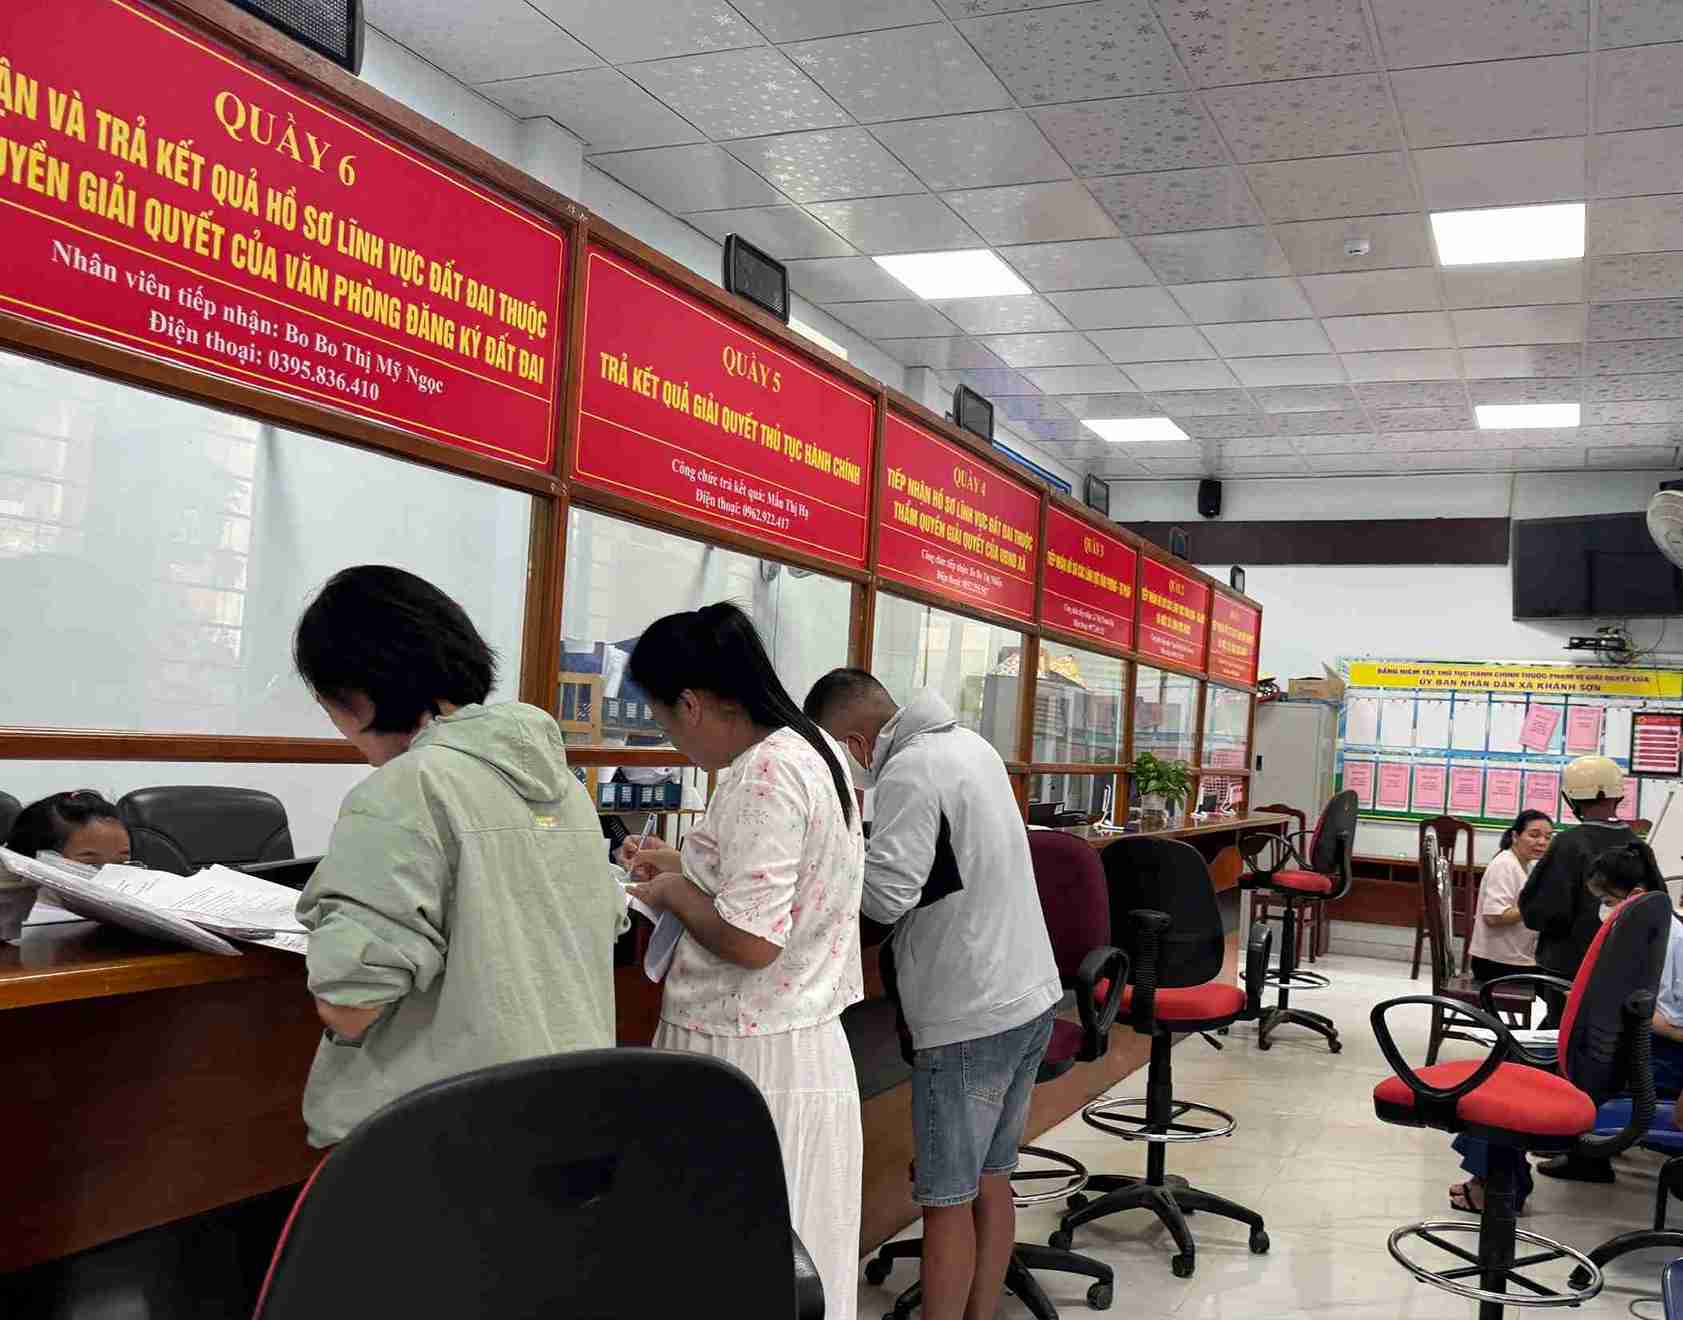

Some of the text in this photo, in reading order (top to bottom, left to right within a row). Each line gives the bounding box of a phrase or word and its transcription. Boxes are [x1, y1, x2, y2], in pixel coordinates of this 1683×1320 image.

[214, 91, 357, 186] QUẦY 6
[48, 86, 87, 143] VÀ
[95, 108, 148, 169] TRẢ
[156, 137, 205, 192] KẾT
[211, 163, 259, 217] QUẢ
[265, 185, 297, 232] HỒ
[303, 205, 333, 247] SƠ
[337, 217, 384, 269] LĨNH
[388, 242, 425, 288] VỰC
[429, 259, 463, 303] ĐẤT
[465, 278, 496, 317] ĐAI
[499, 292, 548, 341] THUỘC
[51, 239, 118, 283] Nhân
[124, 270, 171, 301] viên
[177, 285, 217, 320] tiếp
[223, 304, 279, 338] nhận:
[285, 322, 310, 348] Bo
[342, 341, 372, 375] Thị
[376, 354, 402, 383] Mỹ
[405, 364, 445, 395] Ngọc
[78, 170, 137, 229] GIẢI
[144, 198, 225, 261] QUYẾT
[230, 226, 278, 284] CỦA
[285, 252, 329, 302] VĂN
[333, 273, 402, 330] PHÒNG
[405, 303, 456, 350] ĐĂNG
[458, 325, 482, 359] KÝ
[485, 332, 516, 373] ĐẤT
[518, 348, 545, 385] ĐAI
[148, 310, 380, 401] Điện thoại: 0395.836.410
[722, 346, 781, 393] QUẦY 5
[600, 351, 862, 486] TRẢ KẾT QUẢ GIẢI QUYẾT THỦ TỤC HÀNH CHÍNH
[671, 459, 697, 482] Công
[887, 467, 907, 492] TIẾP
[1434, 677, 1458, 687] BAN
[1459, 677, 1490, 688] NHÂN
